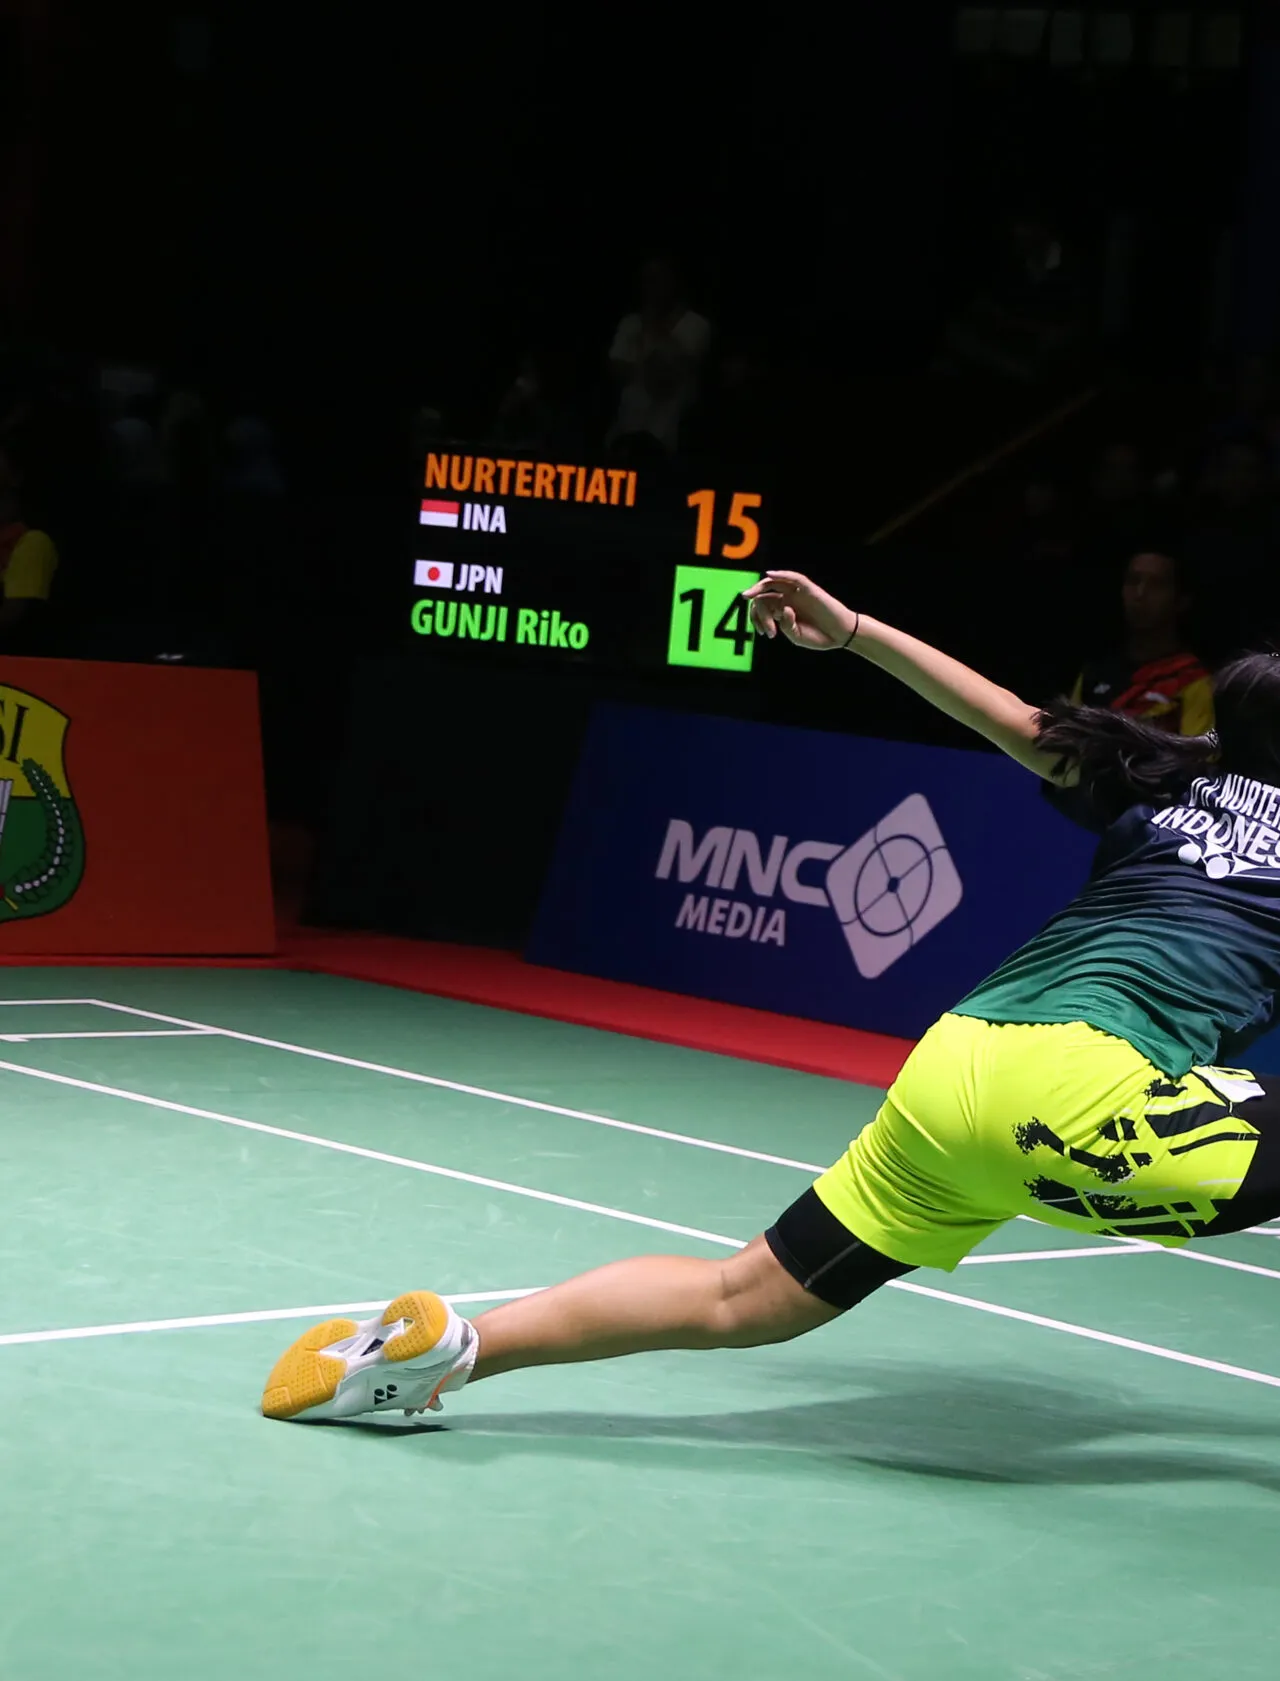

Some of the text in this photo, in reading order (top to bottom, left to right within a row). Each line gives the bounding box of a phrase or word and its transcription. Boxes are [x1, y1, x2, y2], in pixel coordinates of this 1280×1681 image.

[424, 453, 637, 506] NURTERTIATI
[462, 503, 506, 533] INA
[687, 489, 762, 559] 15
[455, 564, 503, 594] JPN
[411, 599, 589, 649] GUNJI Riko
[680, 588, 754, 656] 14
[655, 818, 846, 907] MNC
[675, 894, 786, 946] MEDIA
